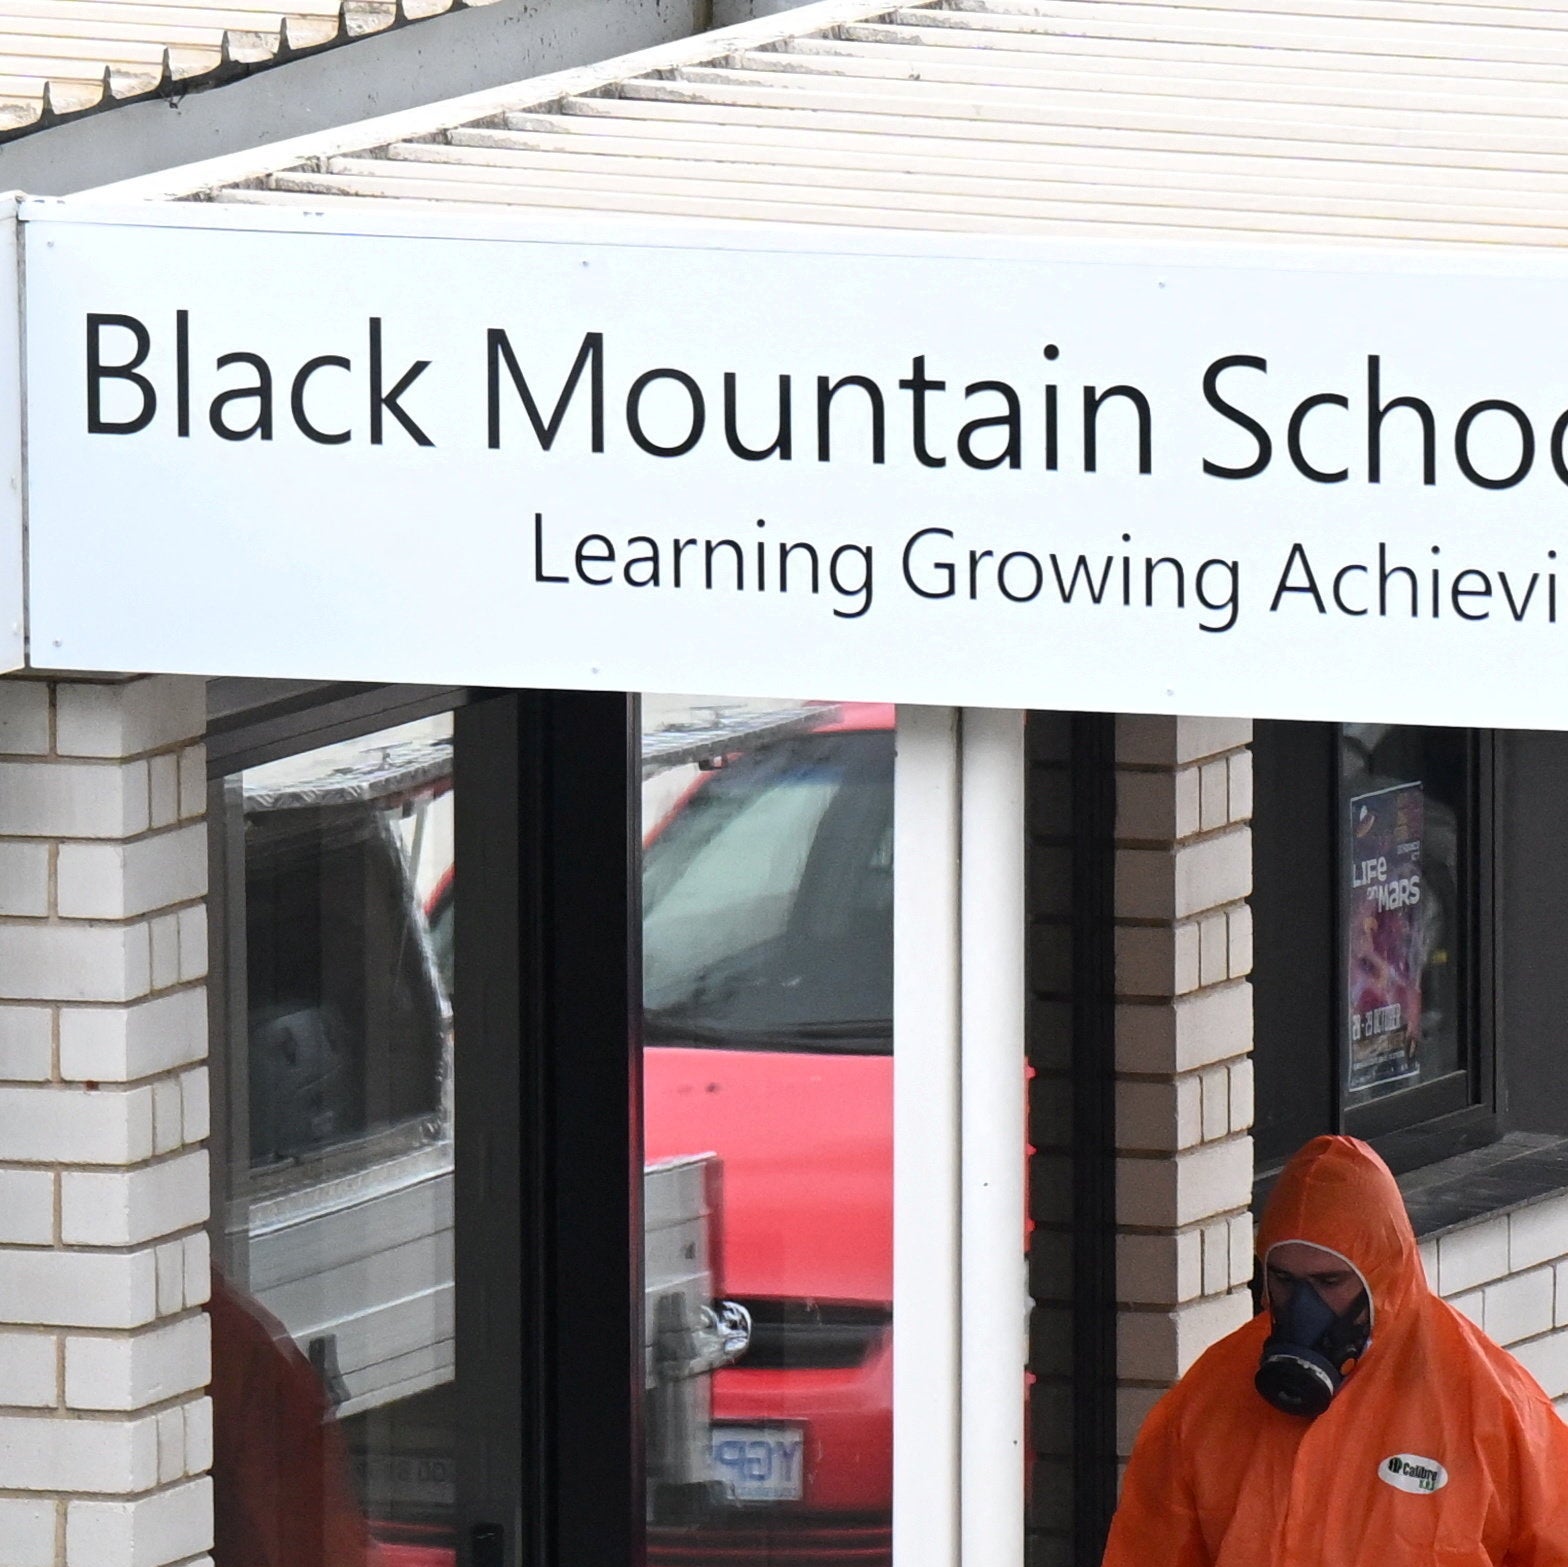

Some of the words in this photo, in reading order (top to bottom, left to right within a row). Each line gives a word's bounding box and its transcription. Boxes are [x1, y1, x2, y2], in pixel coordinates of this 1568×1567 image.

[86, 309, 435, 447] Black
[487, 327, 1152, 475] Mountain
[534, 512, 873, 619] Learning
[902, 527, 1239, 633] Growing
[1402, 1462, 1438, 1482] Calibre
